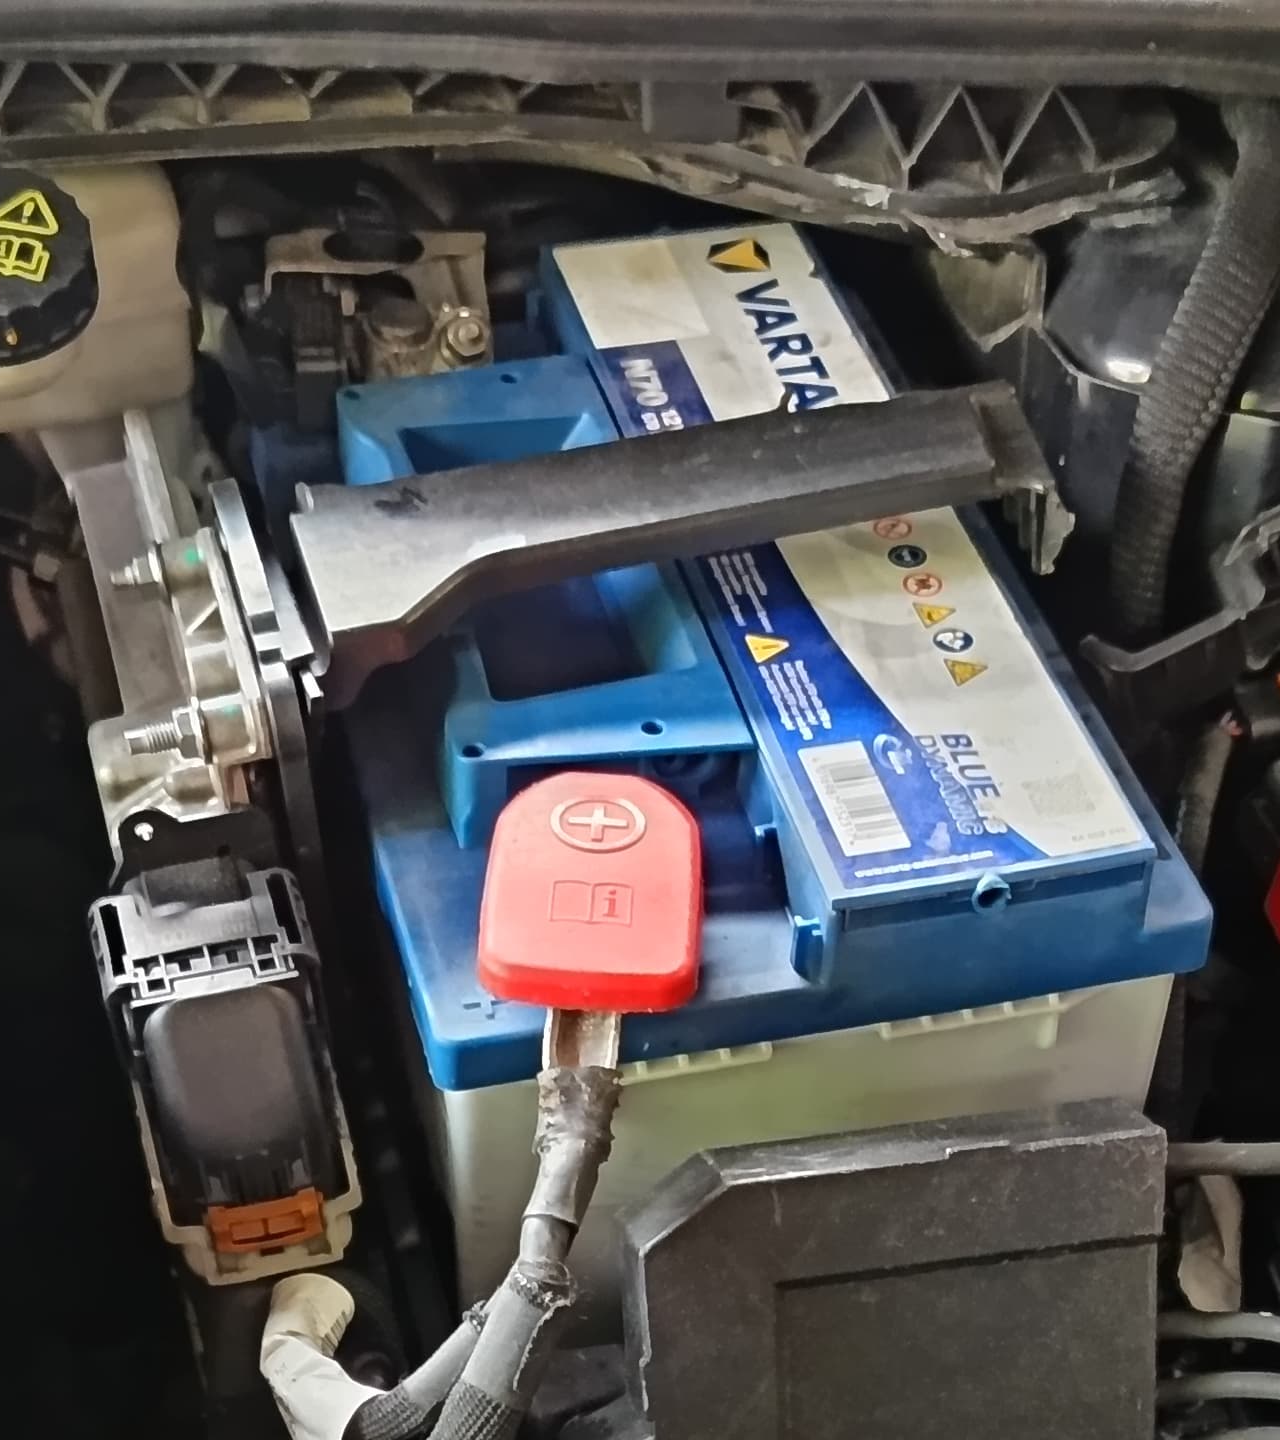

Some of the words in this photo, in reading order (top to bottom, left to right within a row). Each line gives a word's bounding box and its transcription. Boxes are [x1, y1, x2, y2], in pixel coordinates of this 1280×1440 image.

[618, 356, 670, 408] N70
[734, 276, 840, 414] VARTA
[912, 734, 985, 837] DYNAMIC
[940, 733, 1001, 800] BLUE
